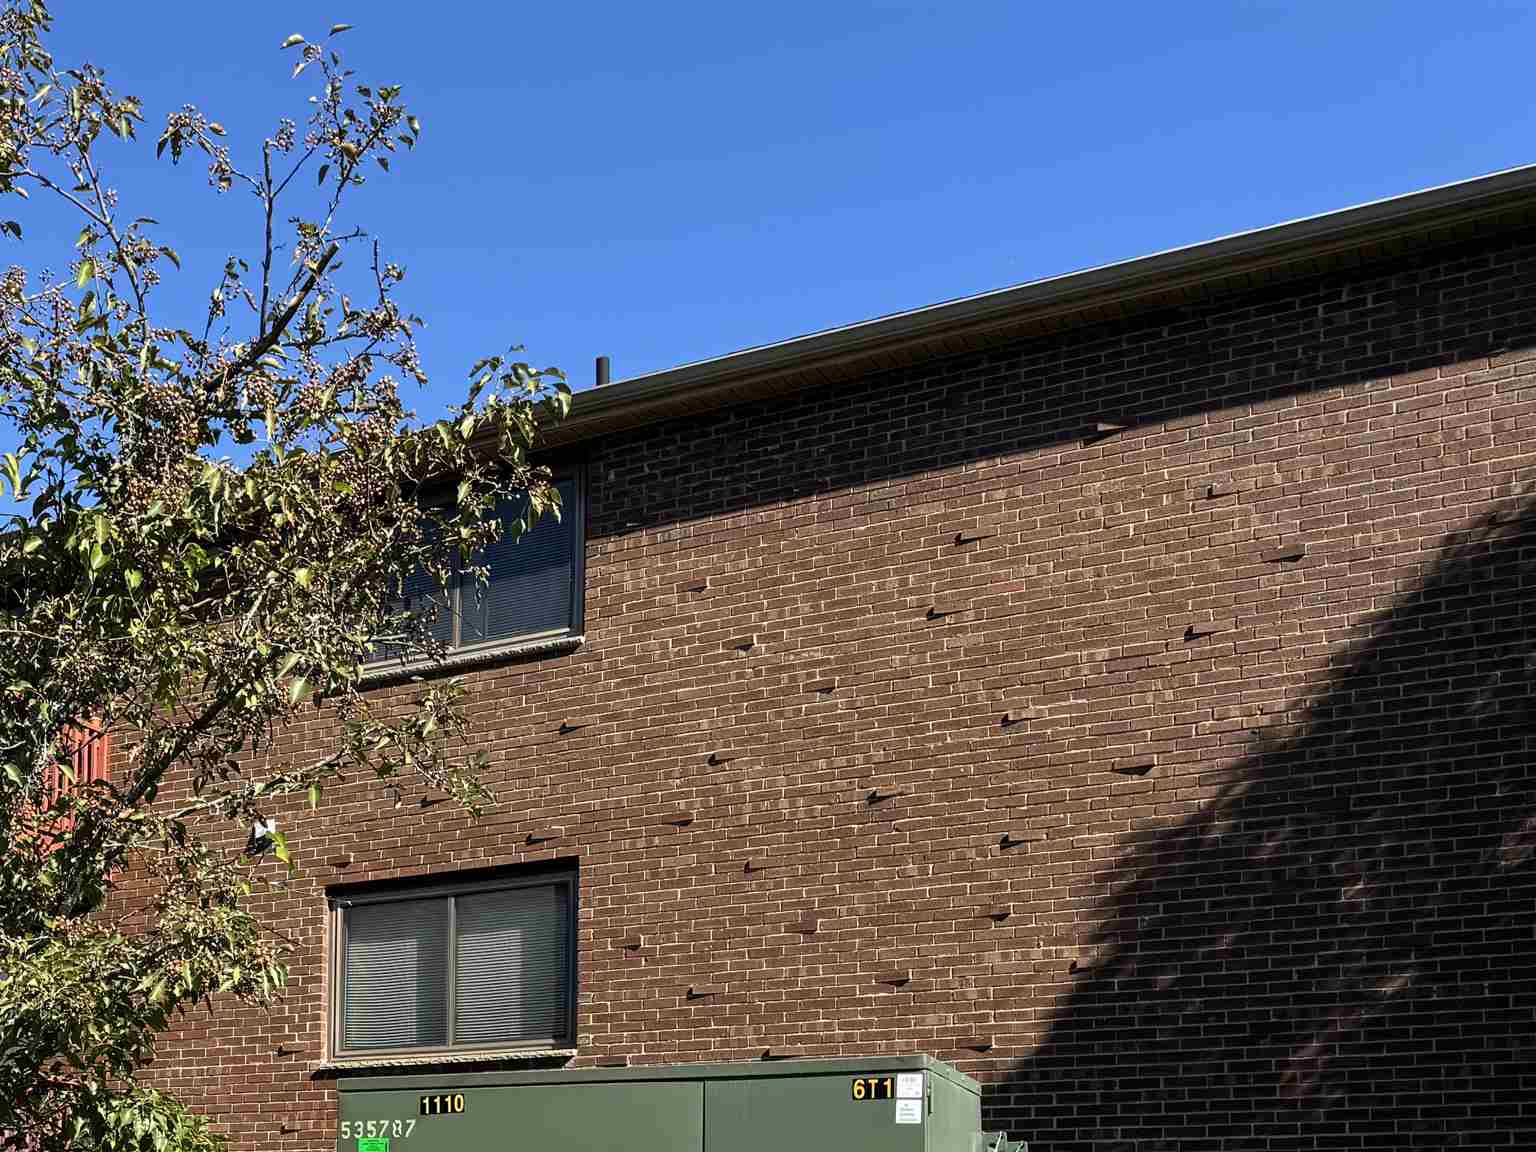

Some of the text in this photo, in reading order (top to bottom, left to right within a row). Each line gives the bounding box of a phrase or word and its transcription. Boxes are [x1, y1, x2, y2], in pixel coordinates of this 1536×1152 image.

[853, 1078, 892, 1099] 6T1
[421, 1094, 465, 1114] 1110
[341, 1119, 416, 1139] 535787
